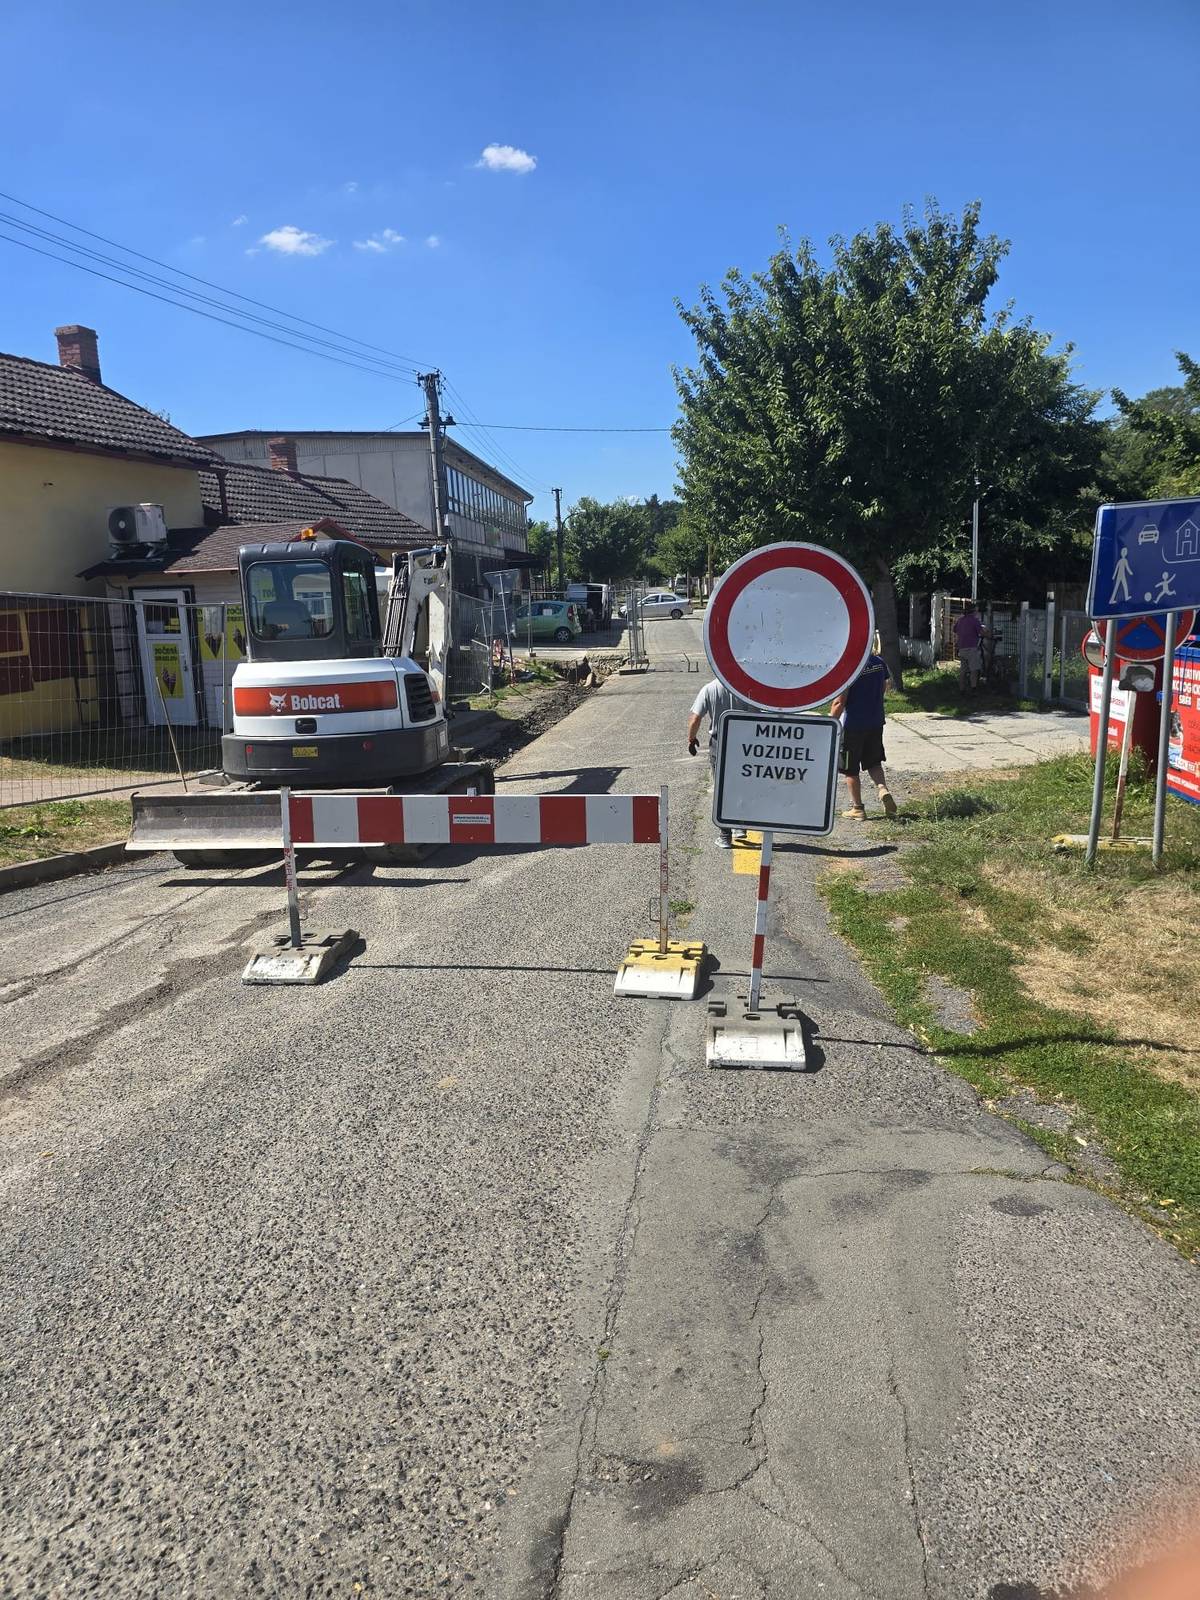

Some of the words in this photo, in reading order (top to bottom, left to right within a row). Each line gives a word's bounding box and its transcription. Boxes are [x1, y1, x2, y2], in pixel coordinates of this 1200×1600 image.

[291, 693, 341, 711] Bobcat
[755, 723, 805, 740] MIMO
[741, 743, 816, 762] VOZIDEL
[741, 763, 808, 781] STAVBY
